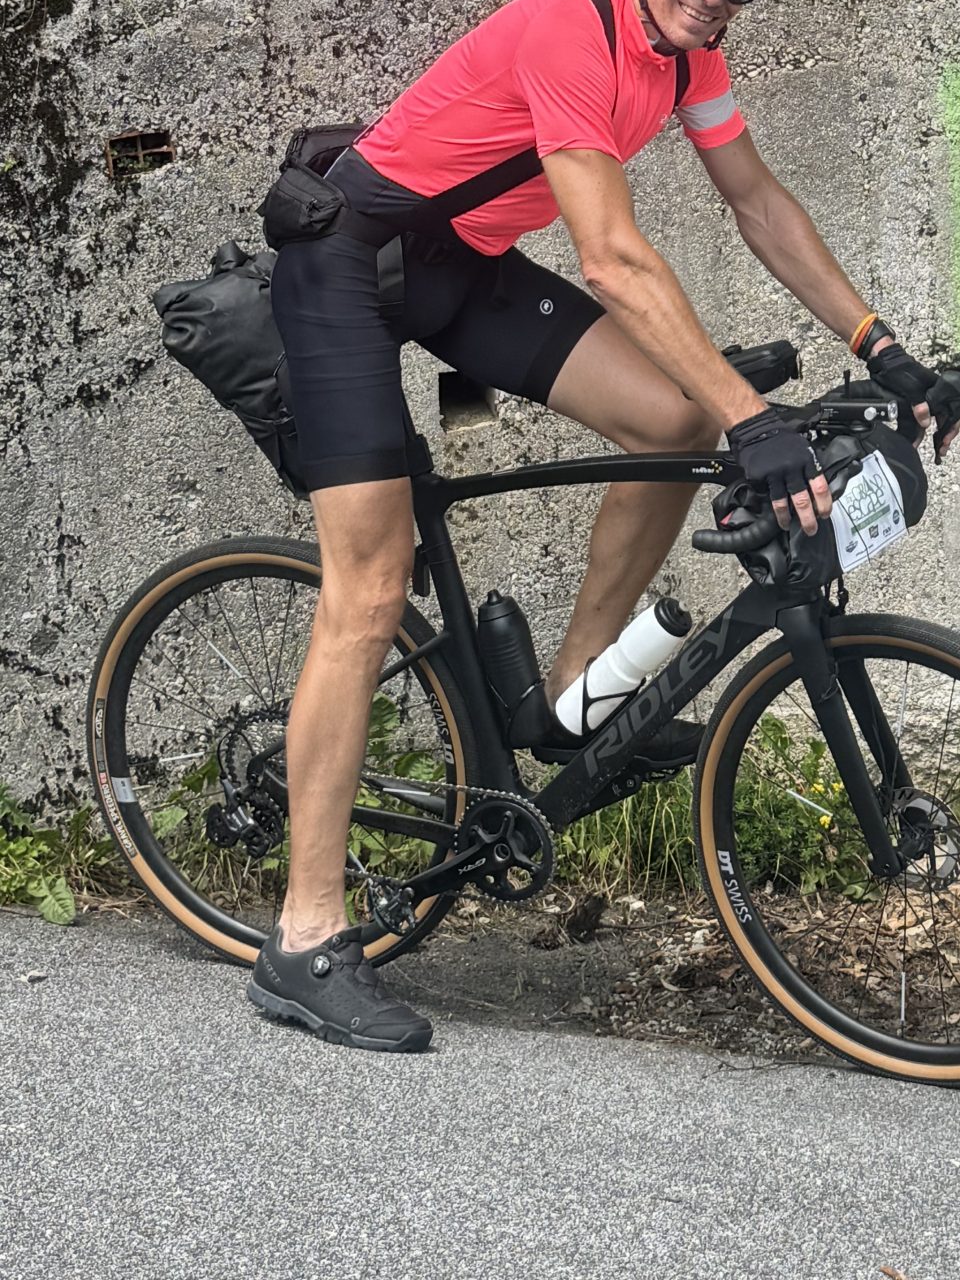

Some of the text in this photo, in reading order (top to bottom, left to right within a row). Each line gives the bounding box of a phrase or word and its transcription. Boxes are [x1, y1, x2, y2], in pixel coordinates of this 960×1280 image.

[583, 606, 734, 778] RIDLEY
[717, 850, 752, 923] DT SWISS
